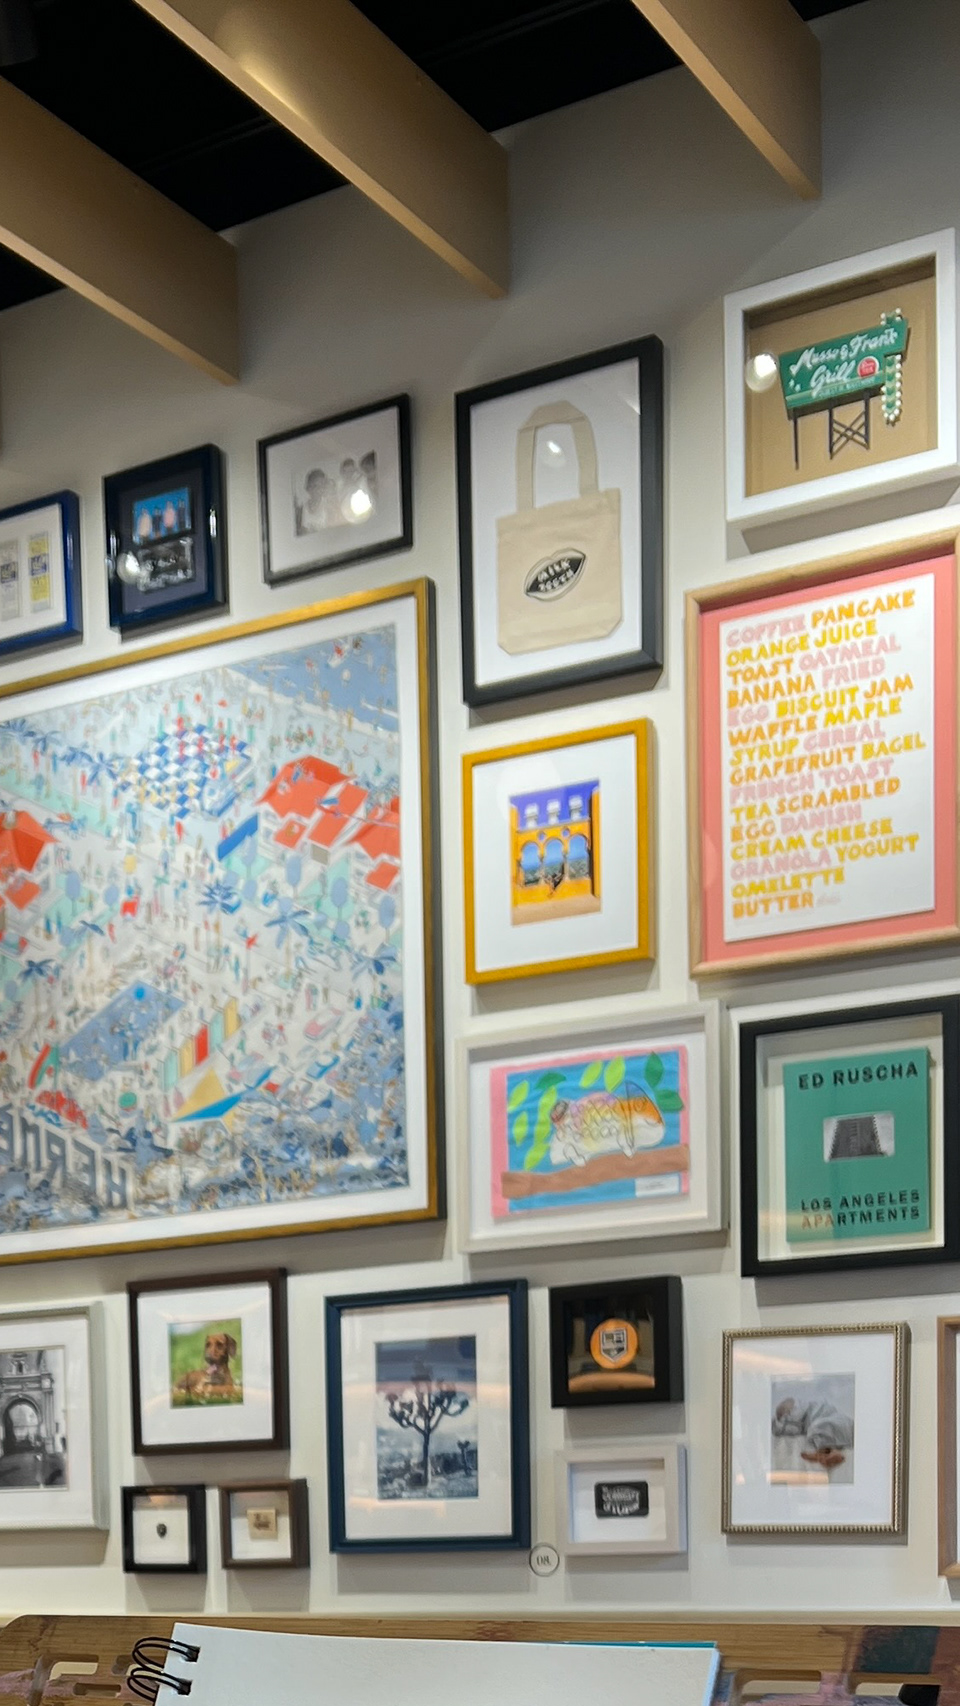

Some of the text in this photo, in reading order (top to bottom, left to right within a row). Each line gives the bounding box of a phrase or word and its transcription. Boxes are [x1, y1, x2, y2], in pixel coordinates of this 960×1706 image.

[790, 347, 840, 377] Musso
[849, 328, 898, 356] Frank
[810, 360, 856, 398] Grill
[726, 589, 916, 648] COFFEE PANCAKE
[726, 619, 877, 668] ORANGE JUICE
[727, 634, 901, 686] TOAST OATMEAL
[727, 658, 885, 709] BANANA FRIED
[727, 673, 913, 728] EGG BISCUIT JAM
[728, 697, 901, 746] WAFFLE MAPLE
[730, 720, 886, 767] SYRUP CEREAL
[729, 732, 926, 786] GRAPEFRUIT BAGEL
[730, 758, 894, 805] FRENCH TOAST
[730, 803, 862, 842] EGG DANISH
[731, 777, 901, 823] TEA SCRAMBLED
[731, 817, 893, 861] CREAM CHEESE
[731, 833, 919, 880] GRANOLA YOGURT
[731, 867, 845, 899] OMELETTE
[732, 891, 814, 919] BUTTER
[798, 1061, 919, 1090] ED RUSCHA
[801, 1189, 920, 1212] LOS ANGELES
[801, 1205, 920, 1229] APARTMENTS
